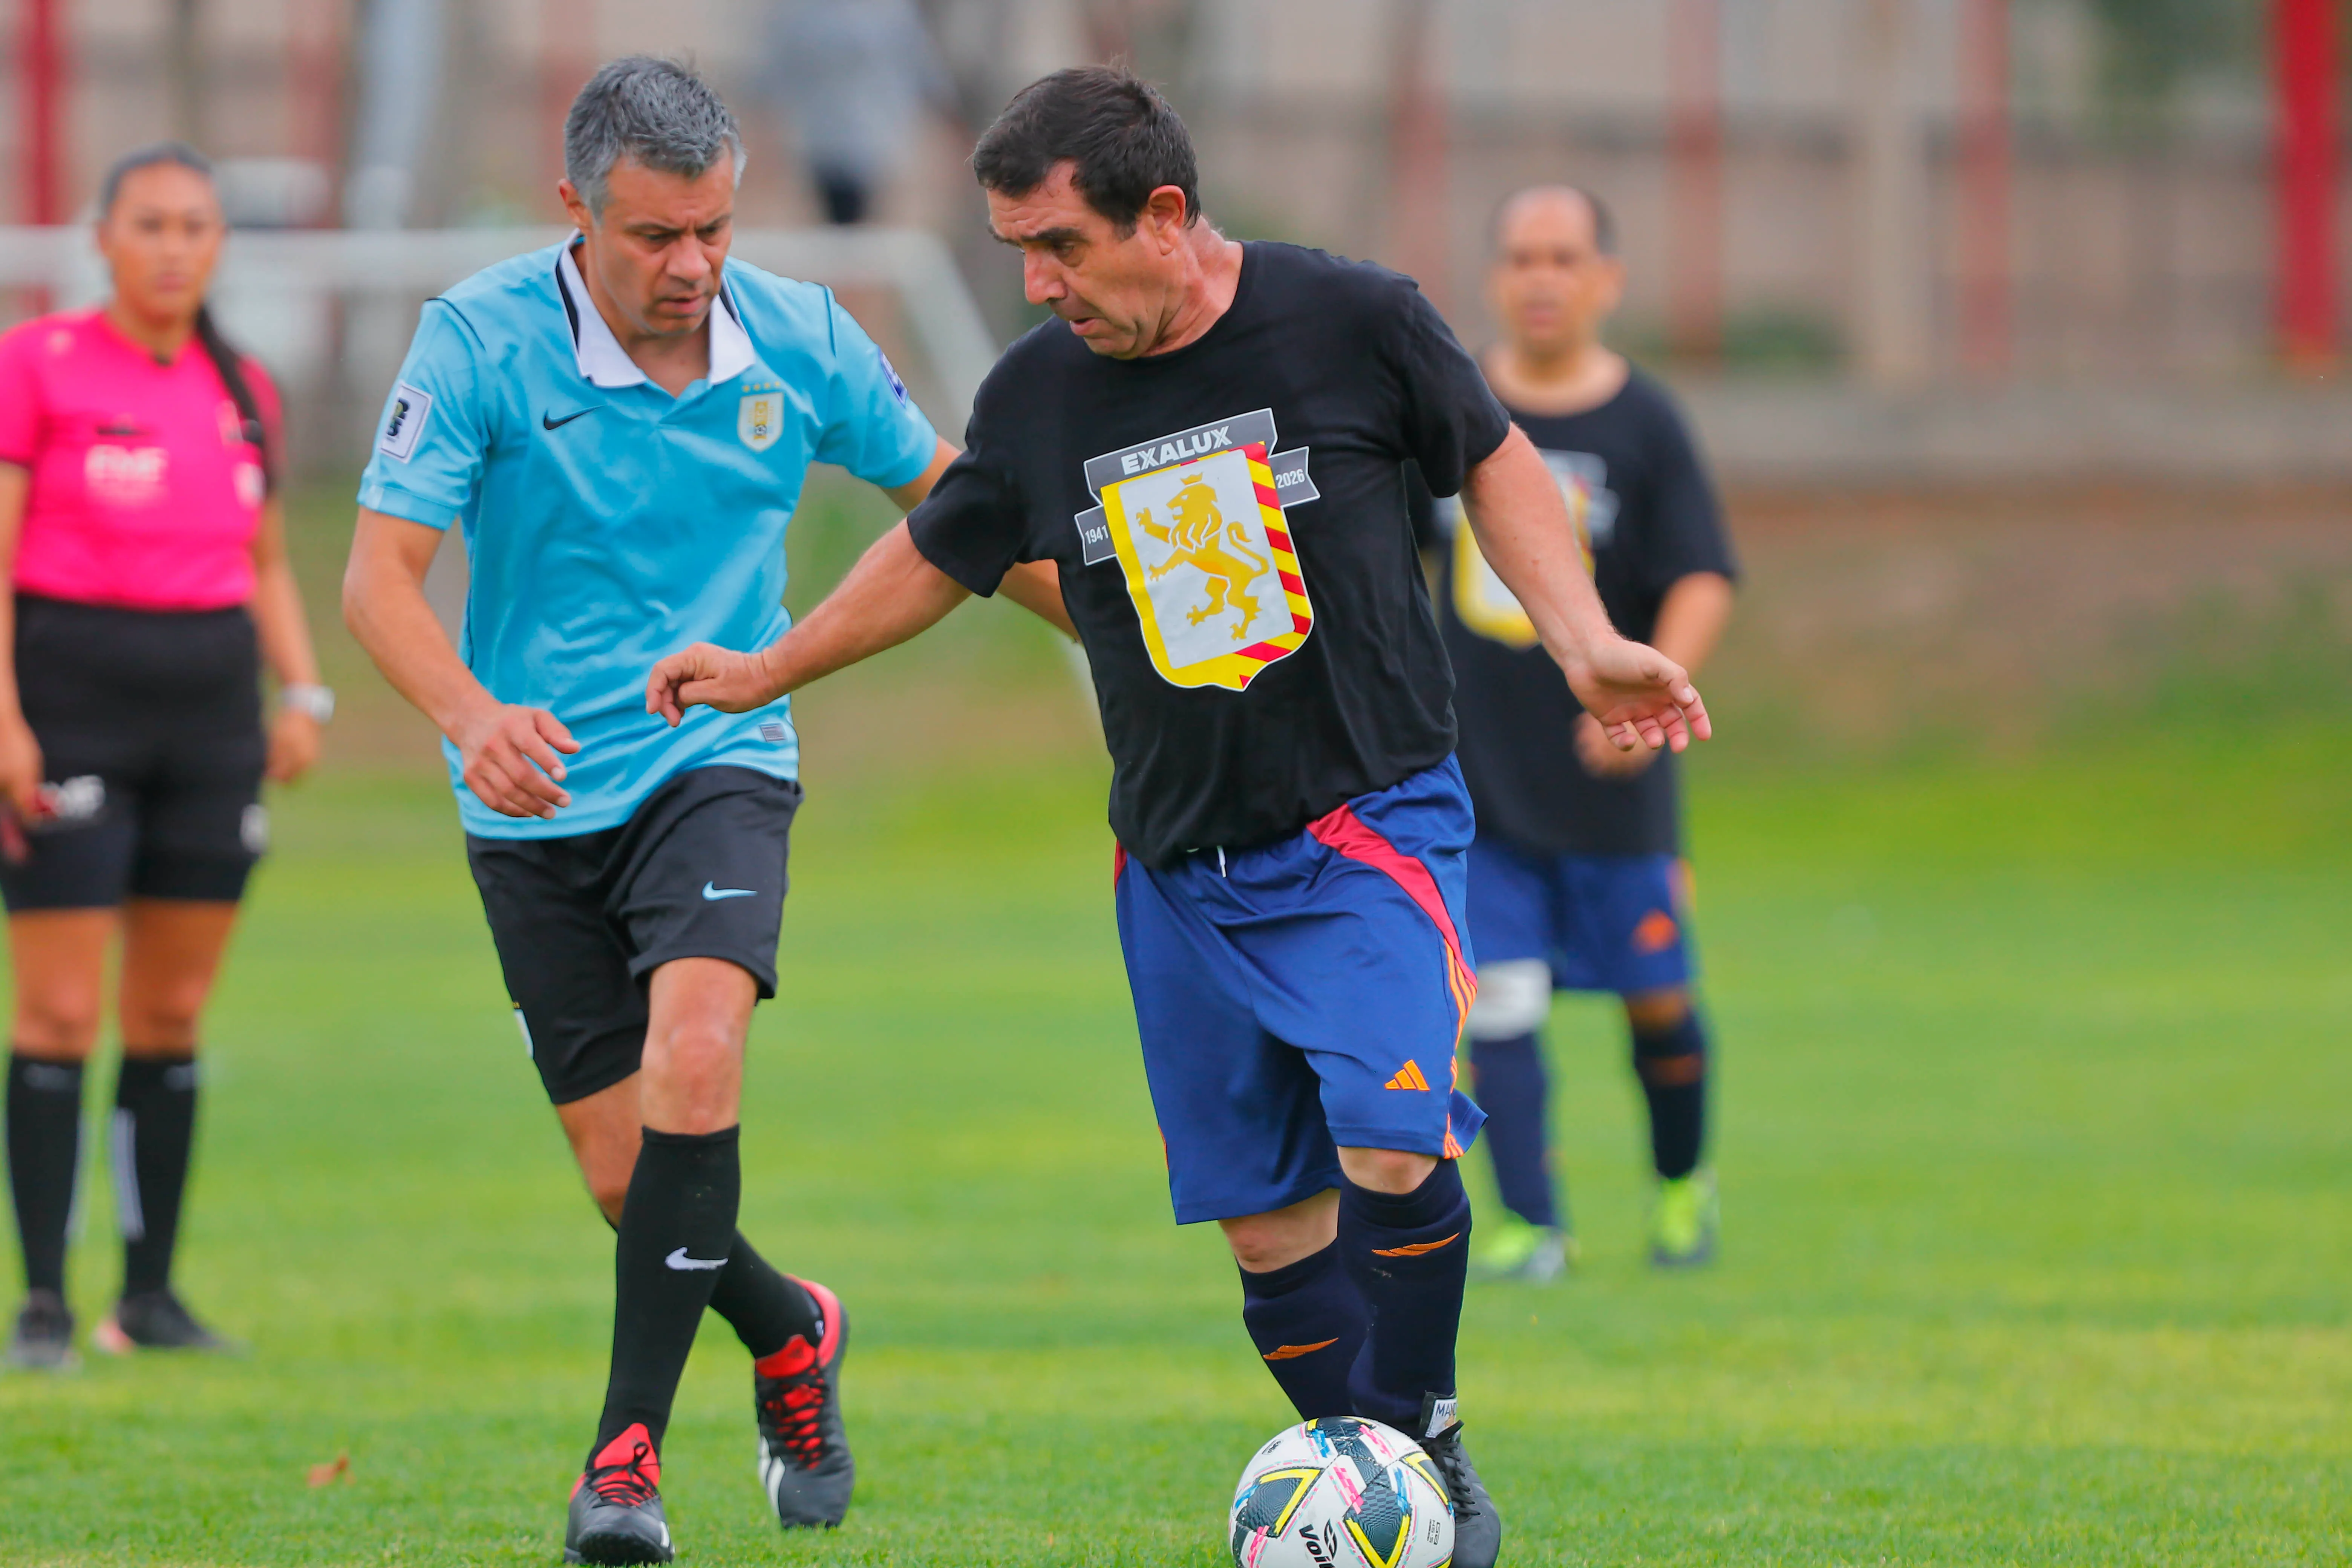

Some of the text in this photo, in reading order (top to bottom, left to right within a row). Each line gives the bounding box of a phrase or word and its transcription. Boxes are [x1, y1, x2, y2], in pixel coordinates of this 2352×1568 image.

[1121, 425, 1233, 475] EXALUX
[1276, 469, 1305, 488] 2026
[1085, 524, 1109, 545] 1941
